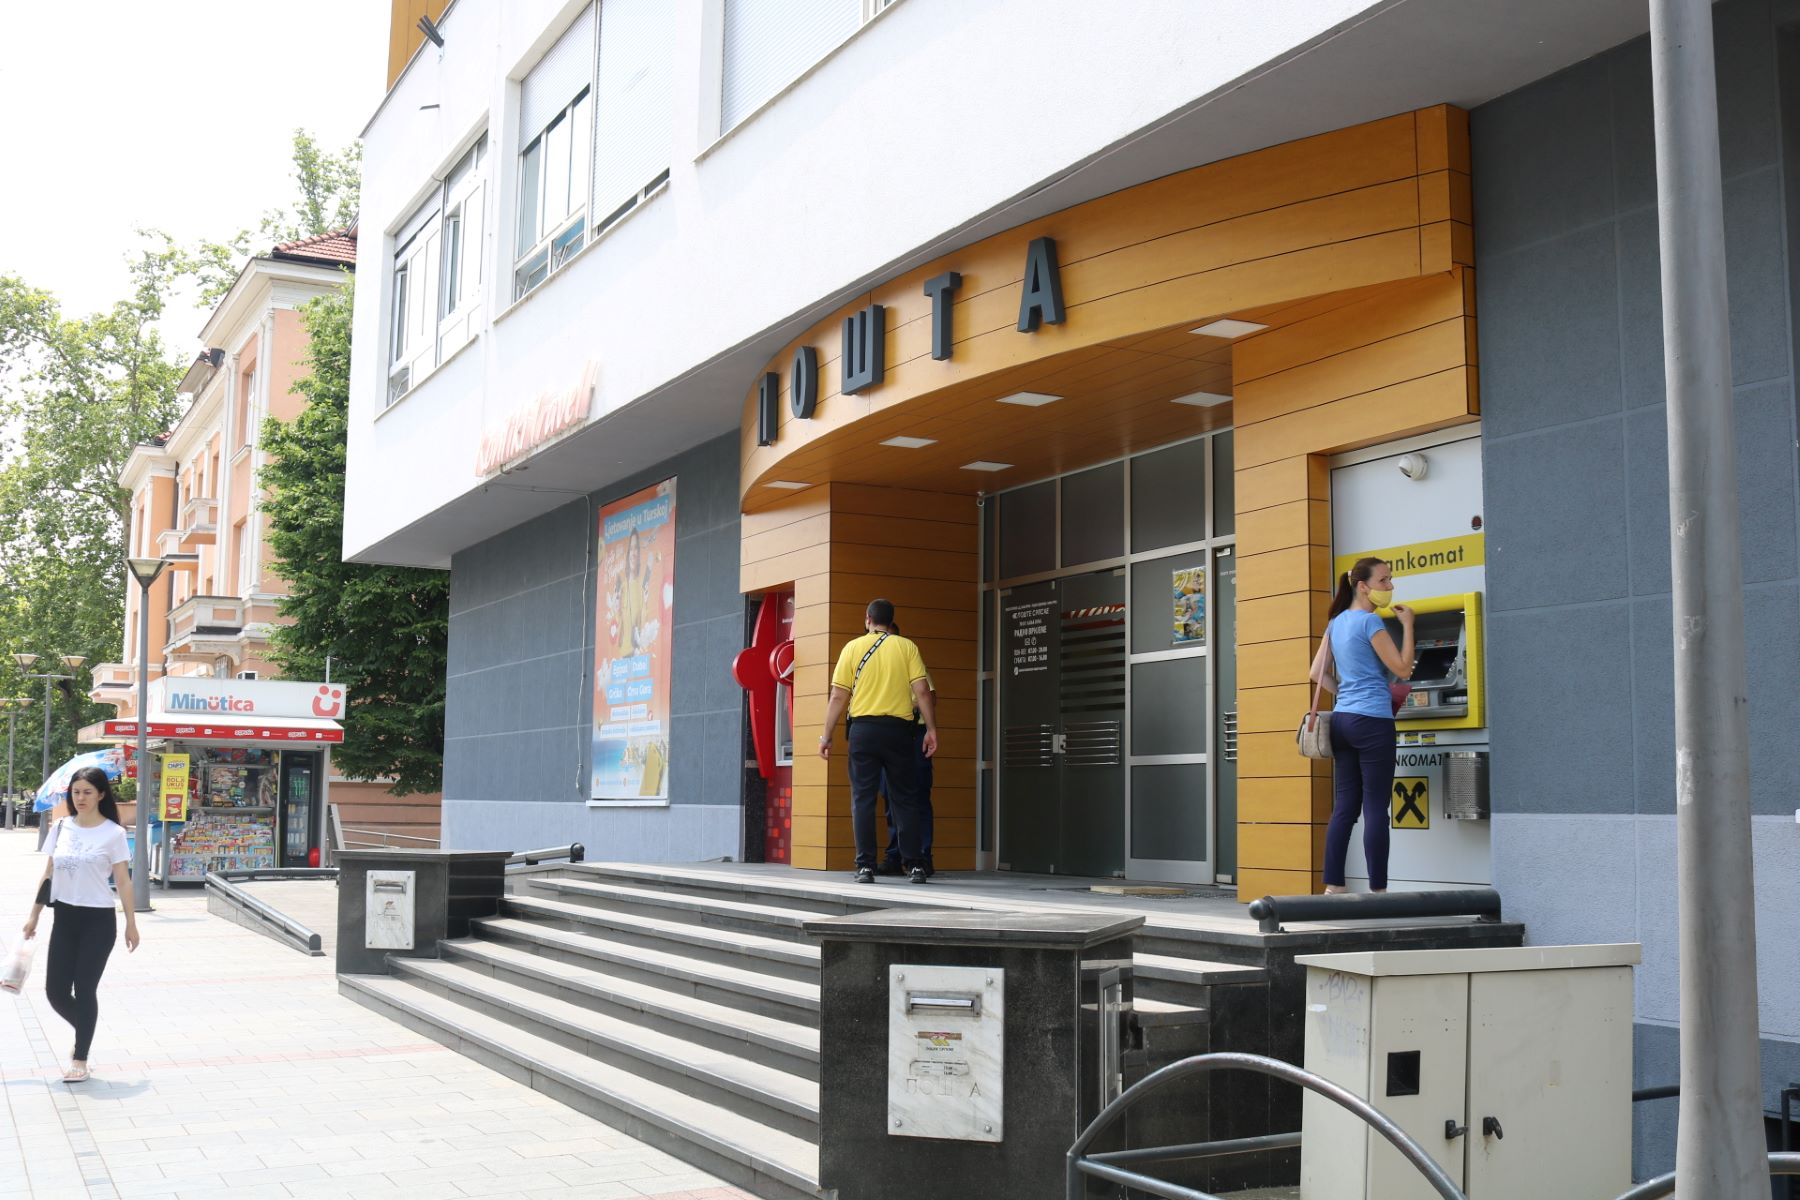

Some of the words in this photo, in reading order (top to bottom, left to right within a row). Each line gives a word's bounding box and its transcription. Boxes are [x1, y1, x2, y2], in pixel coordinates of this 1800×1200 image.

[758, 237, 1065, 446] ПОШТА
[643, 500, 668, 521] Turskoj
[1386, 545, 1464, 572] ankomat
